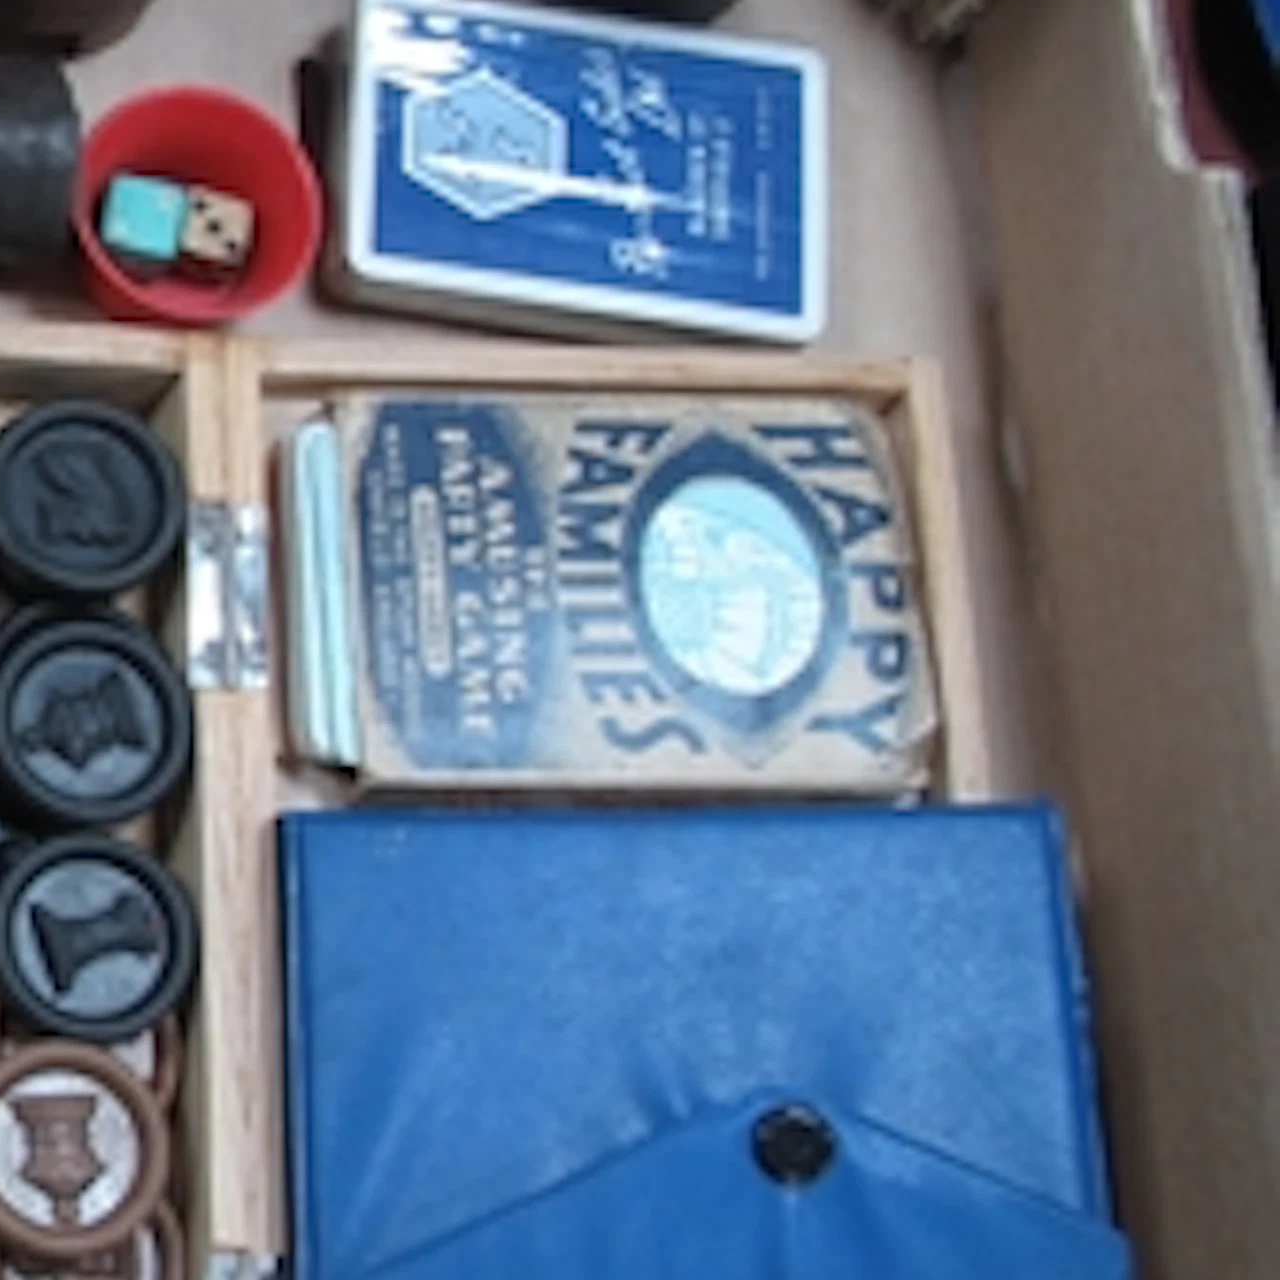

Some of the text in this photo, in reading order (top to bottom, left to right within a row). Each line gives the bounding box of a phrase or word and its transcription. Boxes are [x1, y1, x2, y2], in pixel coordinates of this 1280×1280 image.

[454, 589, 495, 732] GAME
[477, 453, 529, 704] AMUSING
[557, 421, 709, 754] FAMILIES
[749, 424, 909, 754] HAPPY
